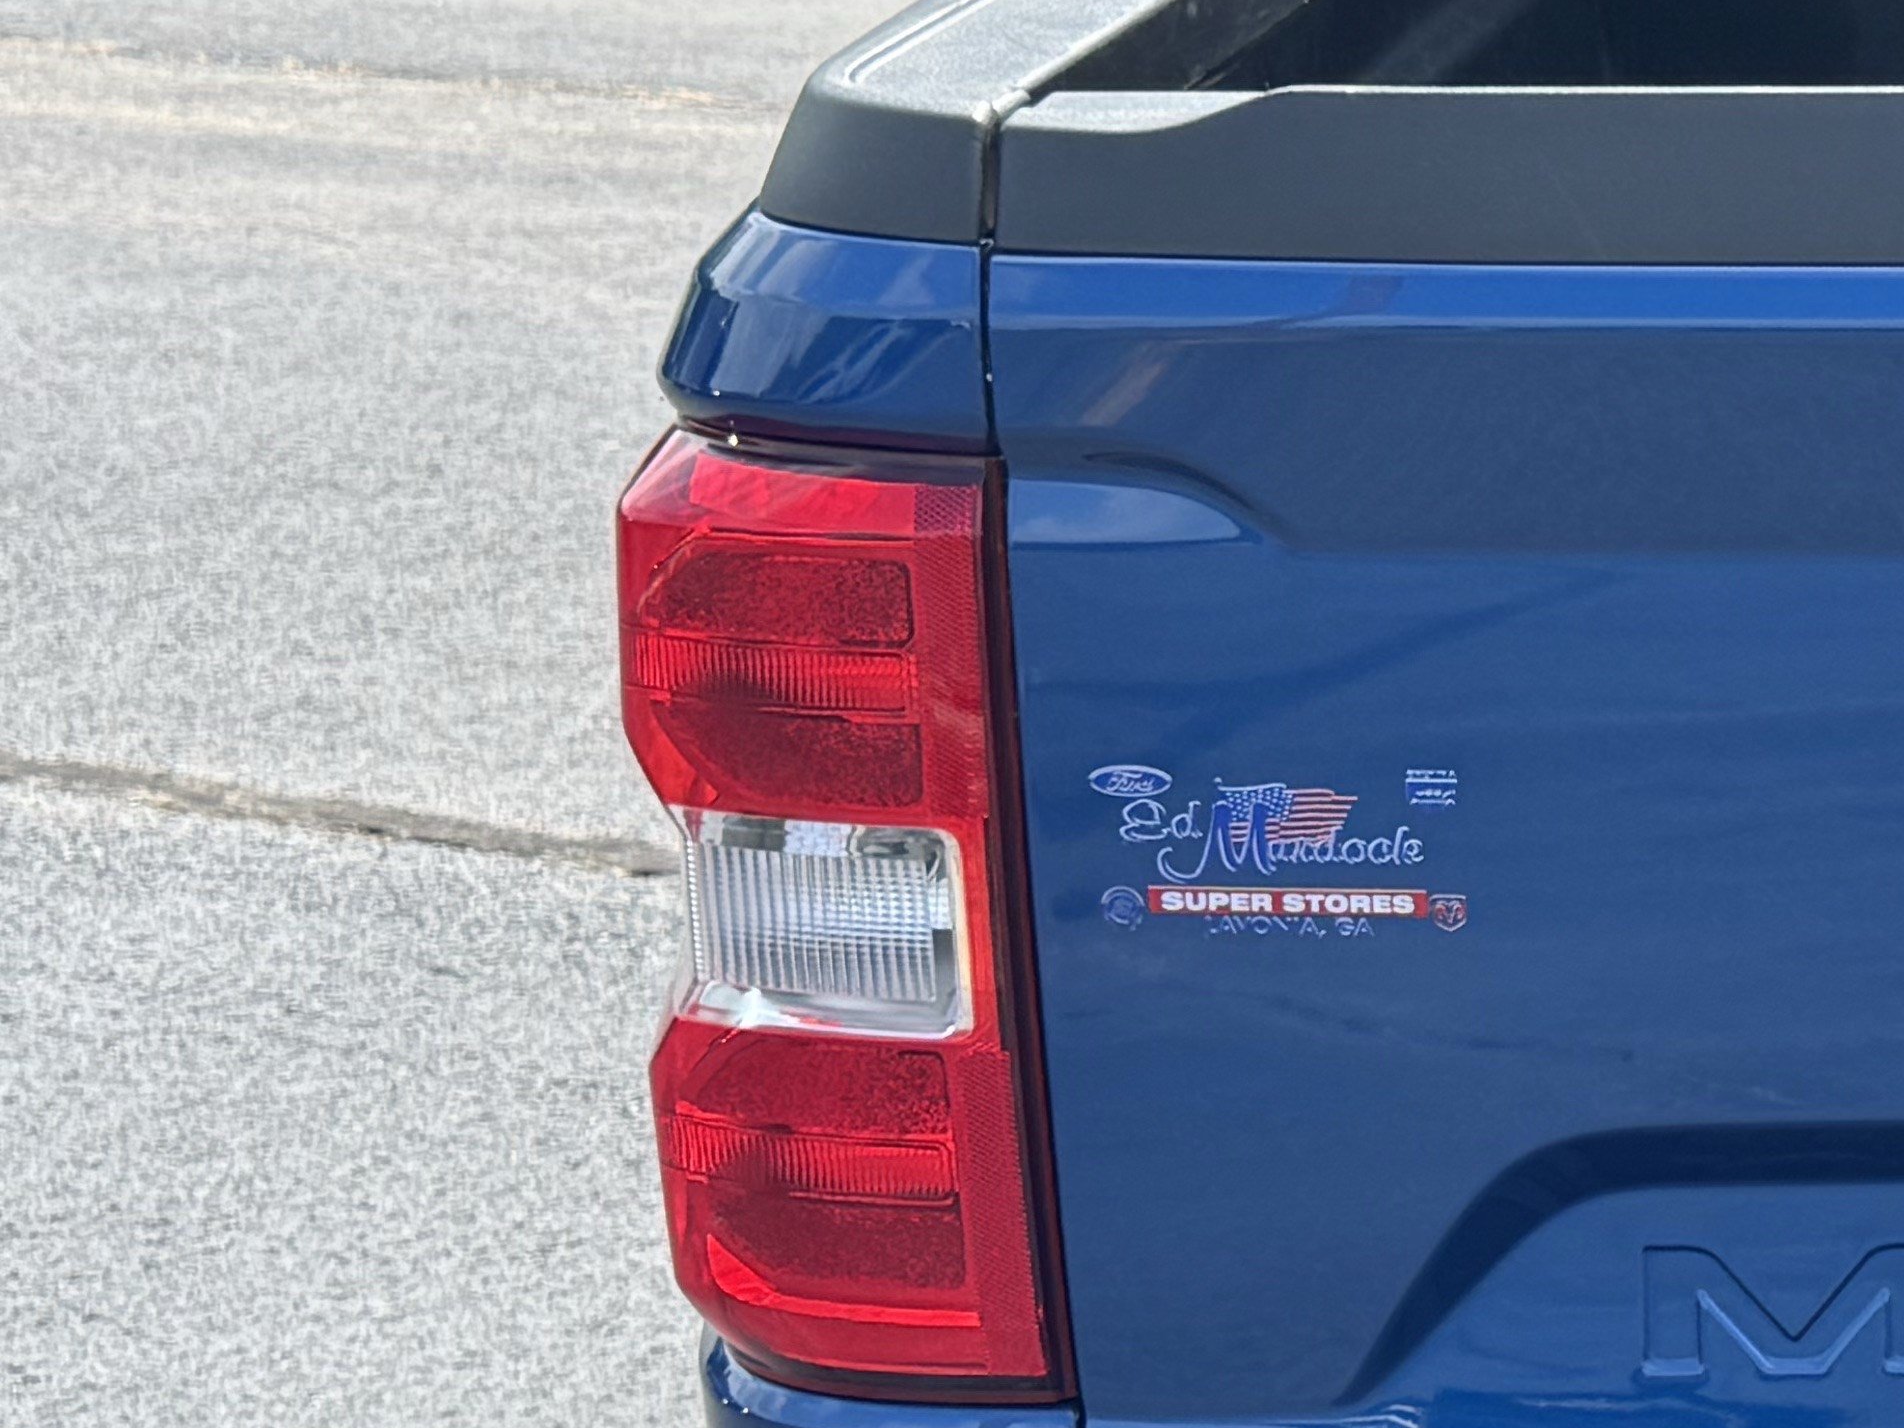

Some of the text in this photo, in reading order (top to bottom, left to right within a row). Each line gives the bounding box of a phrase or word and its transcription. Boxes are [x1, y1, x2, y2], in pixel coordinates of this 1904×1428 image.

[1119, 798, 1203, 842] Ed
[1160, 890, 1416, 915] SUPER STORES
[1334, 916, 1375, 937] GA
